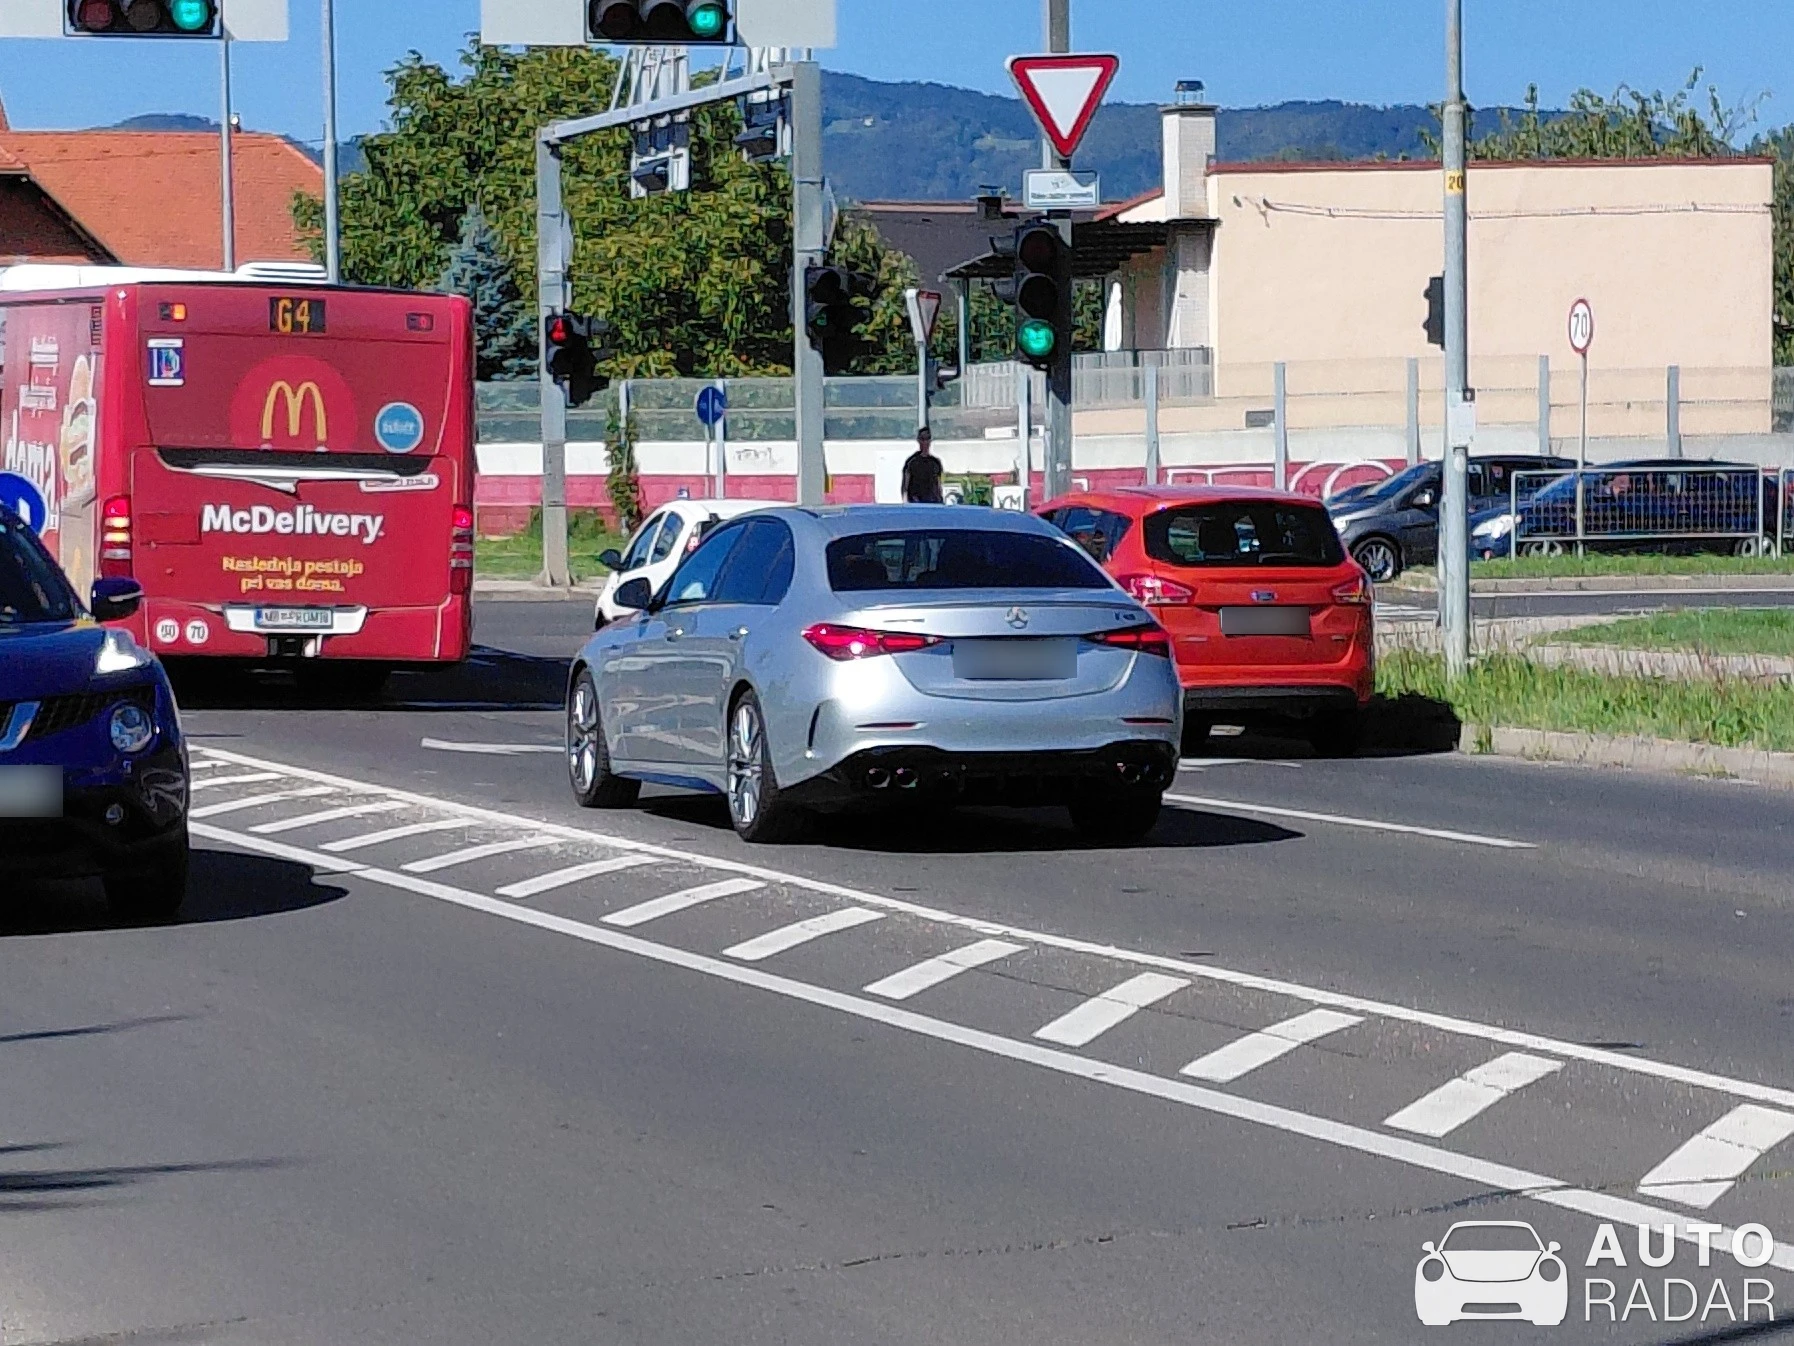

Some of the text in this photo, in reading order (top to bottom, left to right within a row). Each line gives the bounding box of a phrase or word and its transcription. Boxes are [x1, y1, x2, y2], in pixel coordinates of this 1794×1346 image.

[275, 298, 311, 333] G4
[1573, 312, 1588, 340] 70
[190, 625, 206, 639] 70
